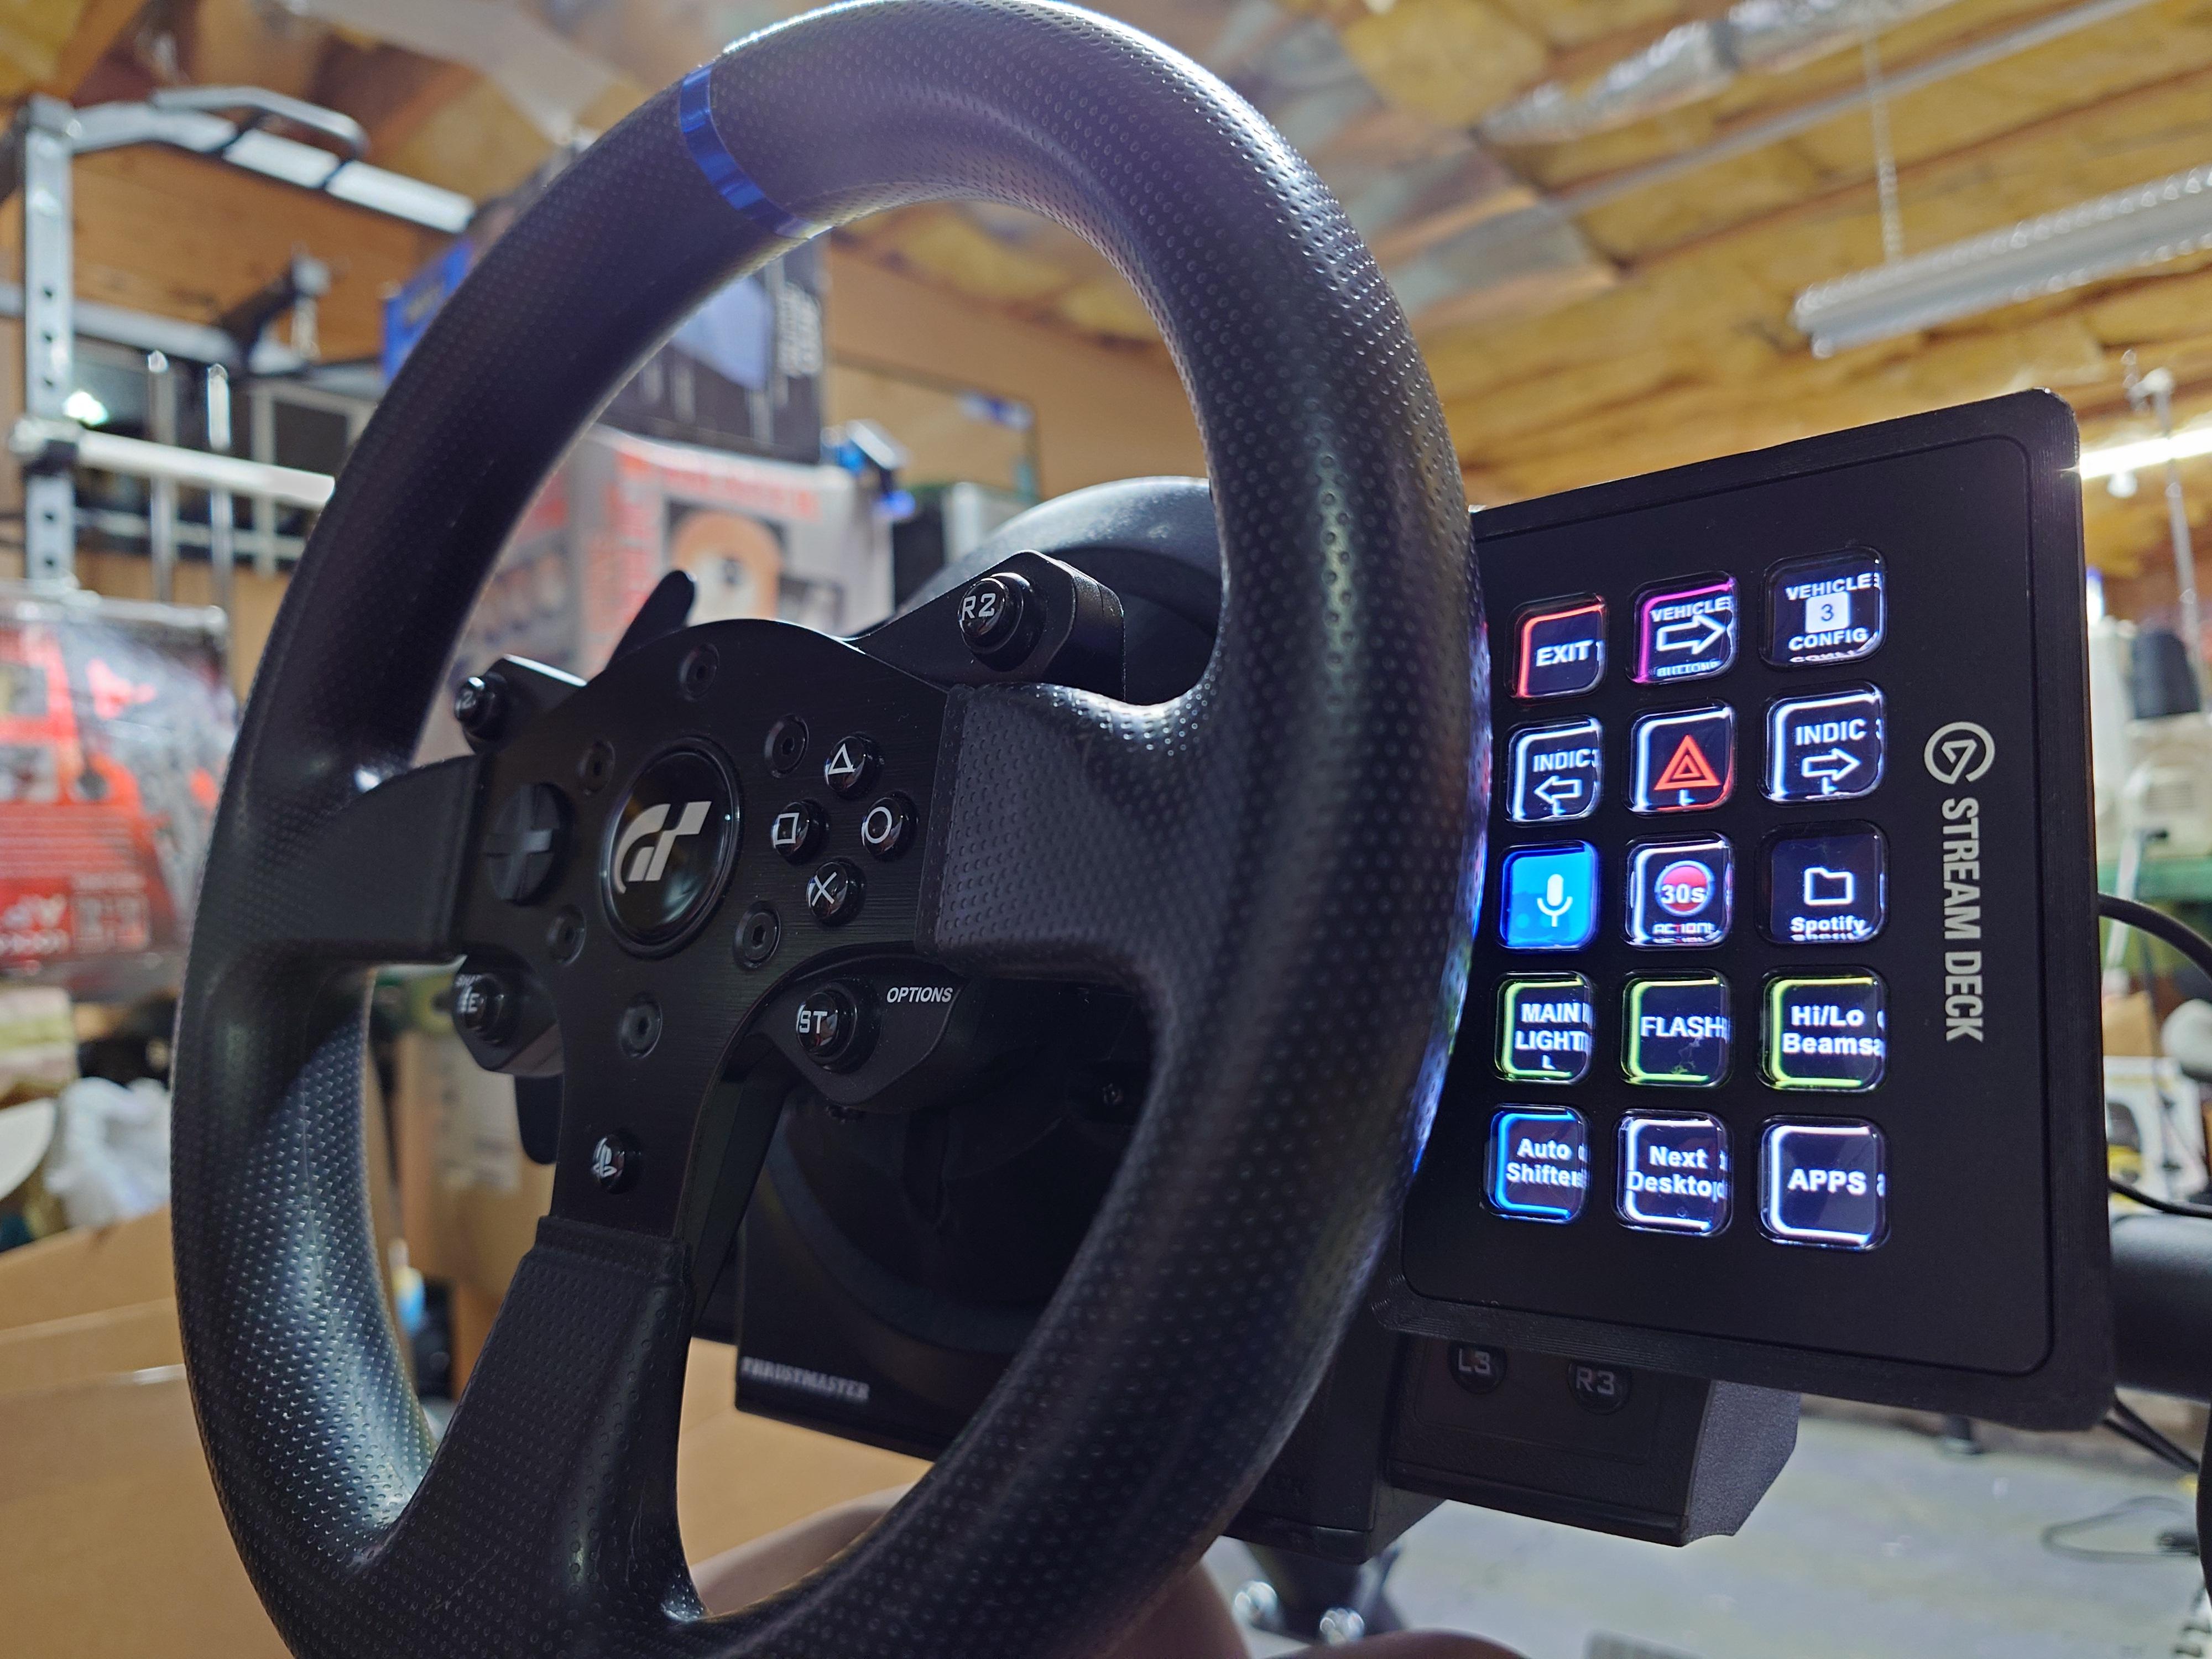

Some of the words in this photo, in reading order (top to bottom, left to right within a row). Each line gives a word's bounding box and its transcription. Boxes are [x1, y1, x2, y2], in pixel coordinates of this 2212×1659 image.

[1786, 572, 1873, 601] VEHICLE
[962, 593, 995, 620] R2
[1650, 595, 1731, 622] VEHICLE
[1821, 604, 1834, 621] 3
[1789, 628, 1868, 651] CONFIG
[1536, 639, 1594, 666] EXIT
[1796, 719, 1866, 745] INDIC
[1533, 749, 1591, 772] INDIC
[1942, 797, 1981, 940] STREAM
[1661, 883, 1705, 904] 30s
[1790, 915, 1866, 937] Spotify
[886, 987, 953, 1003] OPTIONS
[1945, 951, 1984, 1042] DECK
[1521, 1003, 1582, 1023] MAIN
[1791, 1005, 1865, 1026] Hi/Lo
[1641, 1016, 1724, 1038] FLASH
[1517, 1138, 1572, 1161] Auto
[1650, 1146, 1708, 1169] Next
[1787, 1168, 1867, 1196] APPS
[1458, 1349, 1491, 1375] L3
[1575, 1366, 1615, 1395] R3
